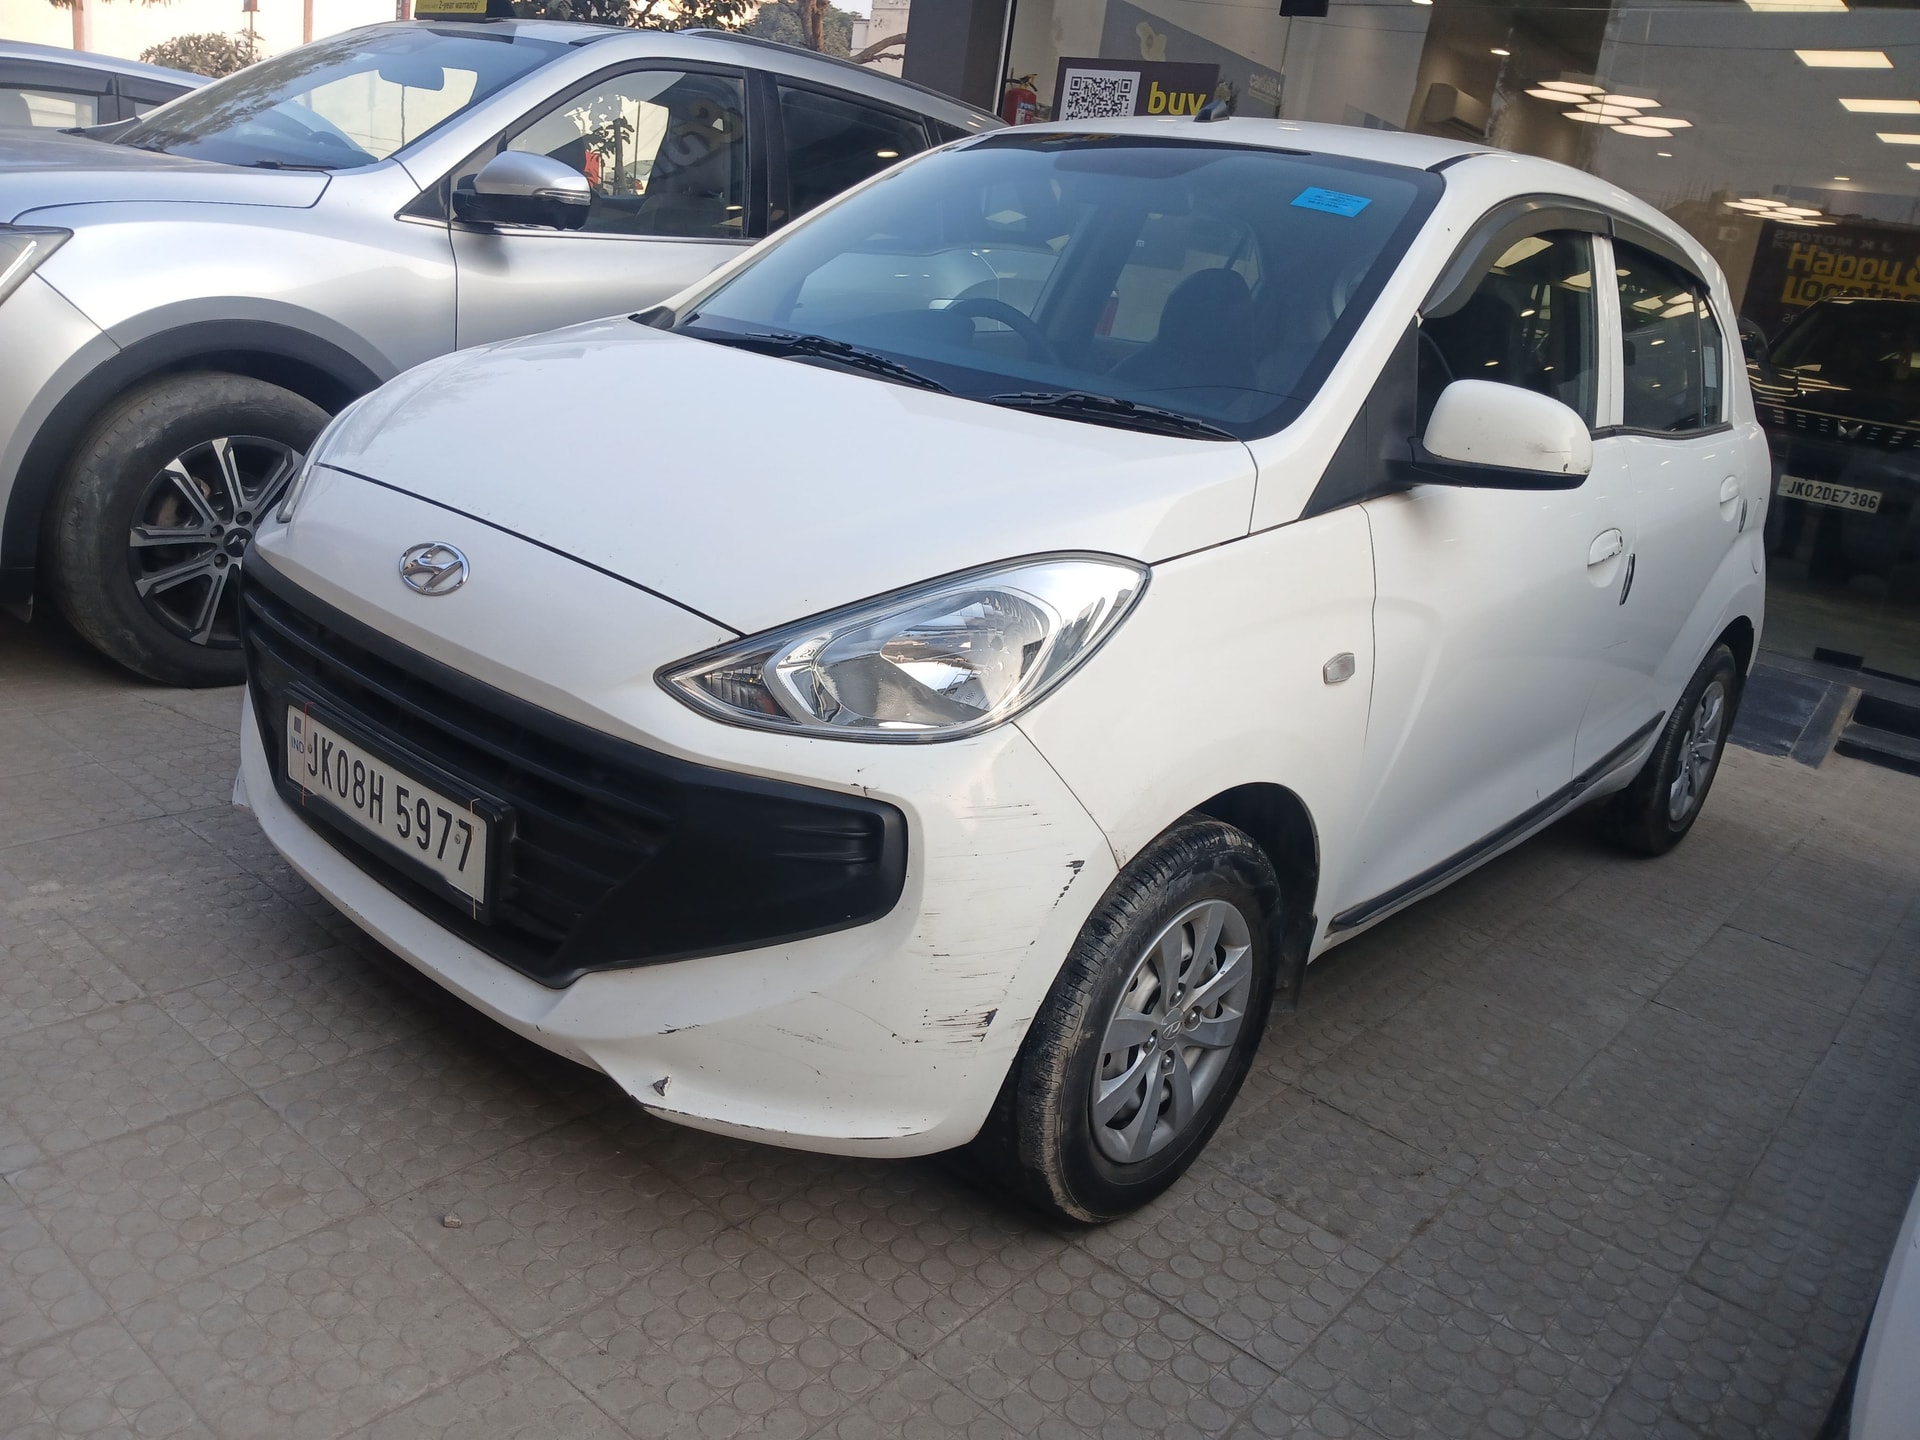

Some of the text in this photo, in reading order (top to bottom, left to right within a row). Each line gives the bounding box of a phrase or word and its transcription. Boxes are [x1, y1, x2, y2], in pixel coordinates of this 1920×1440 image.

[1787, 242, 1903, 287] Happy
[1786, 481, 1878, 509] JK02DE7386
[307, 732, 474, 873] JK08H 5977
